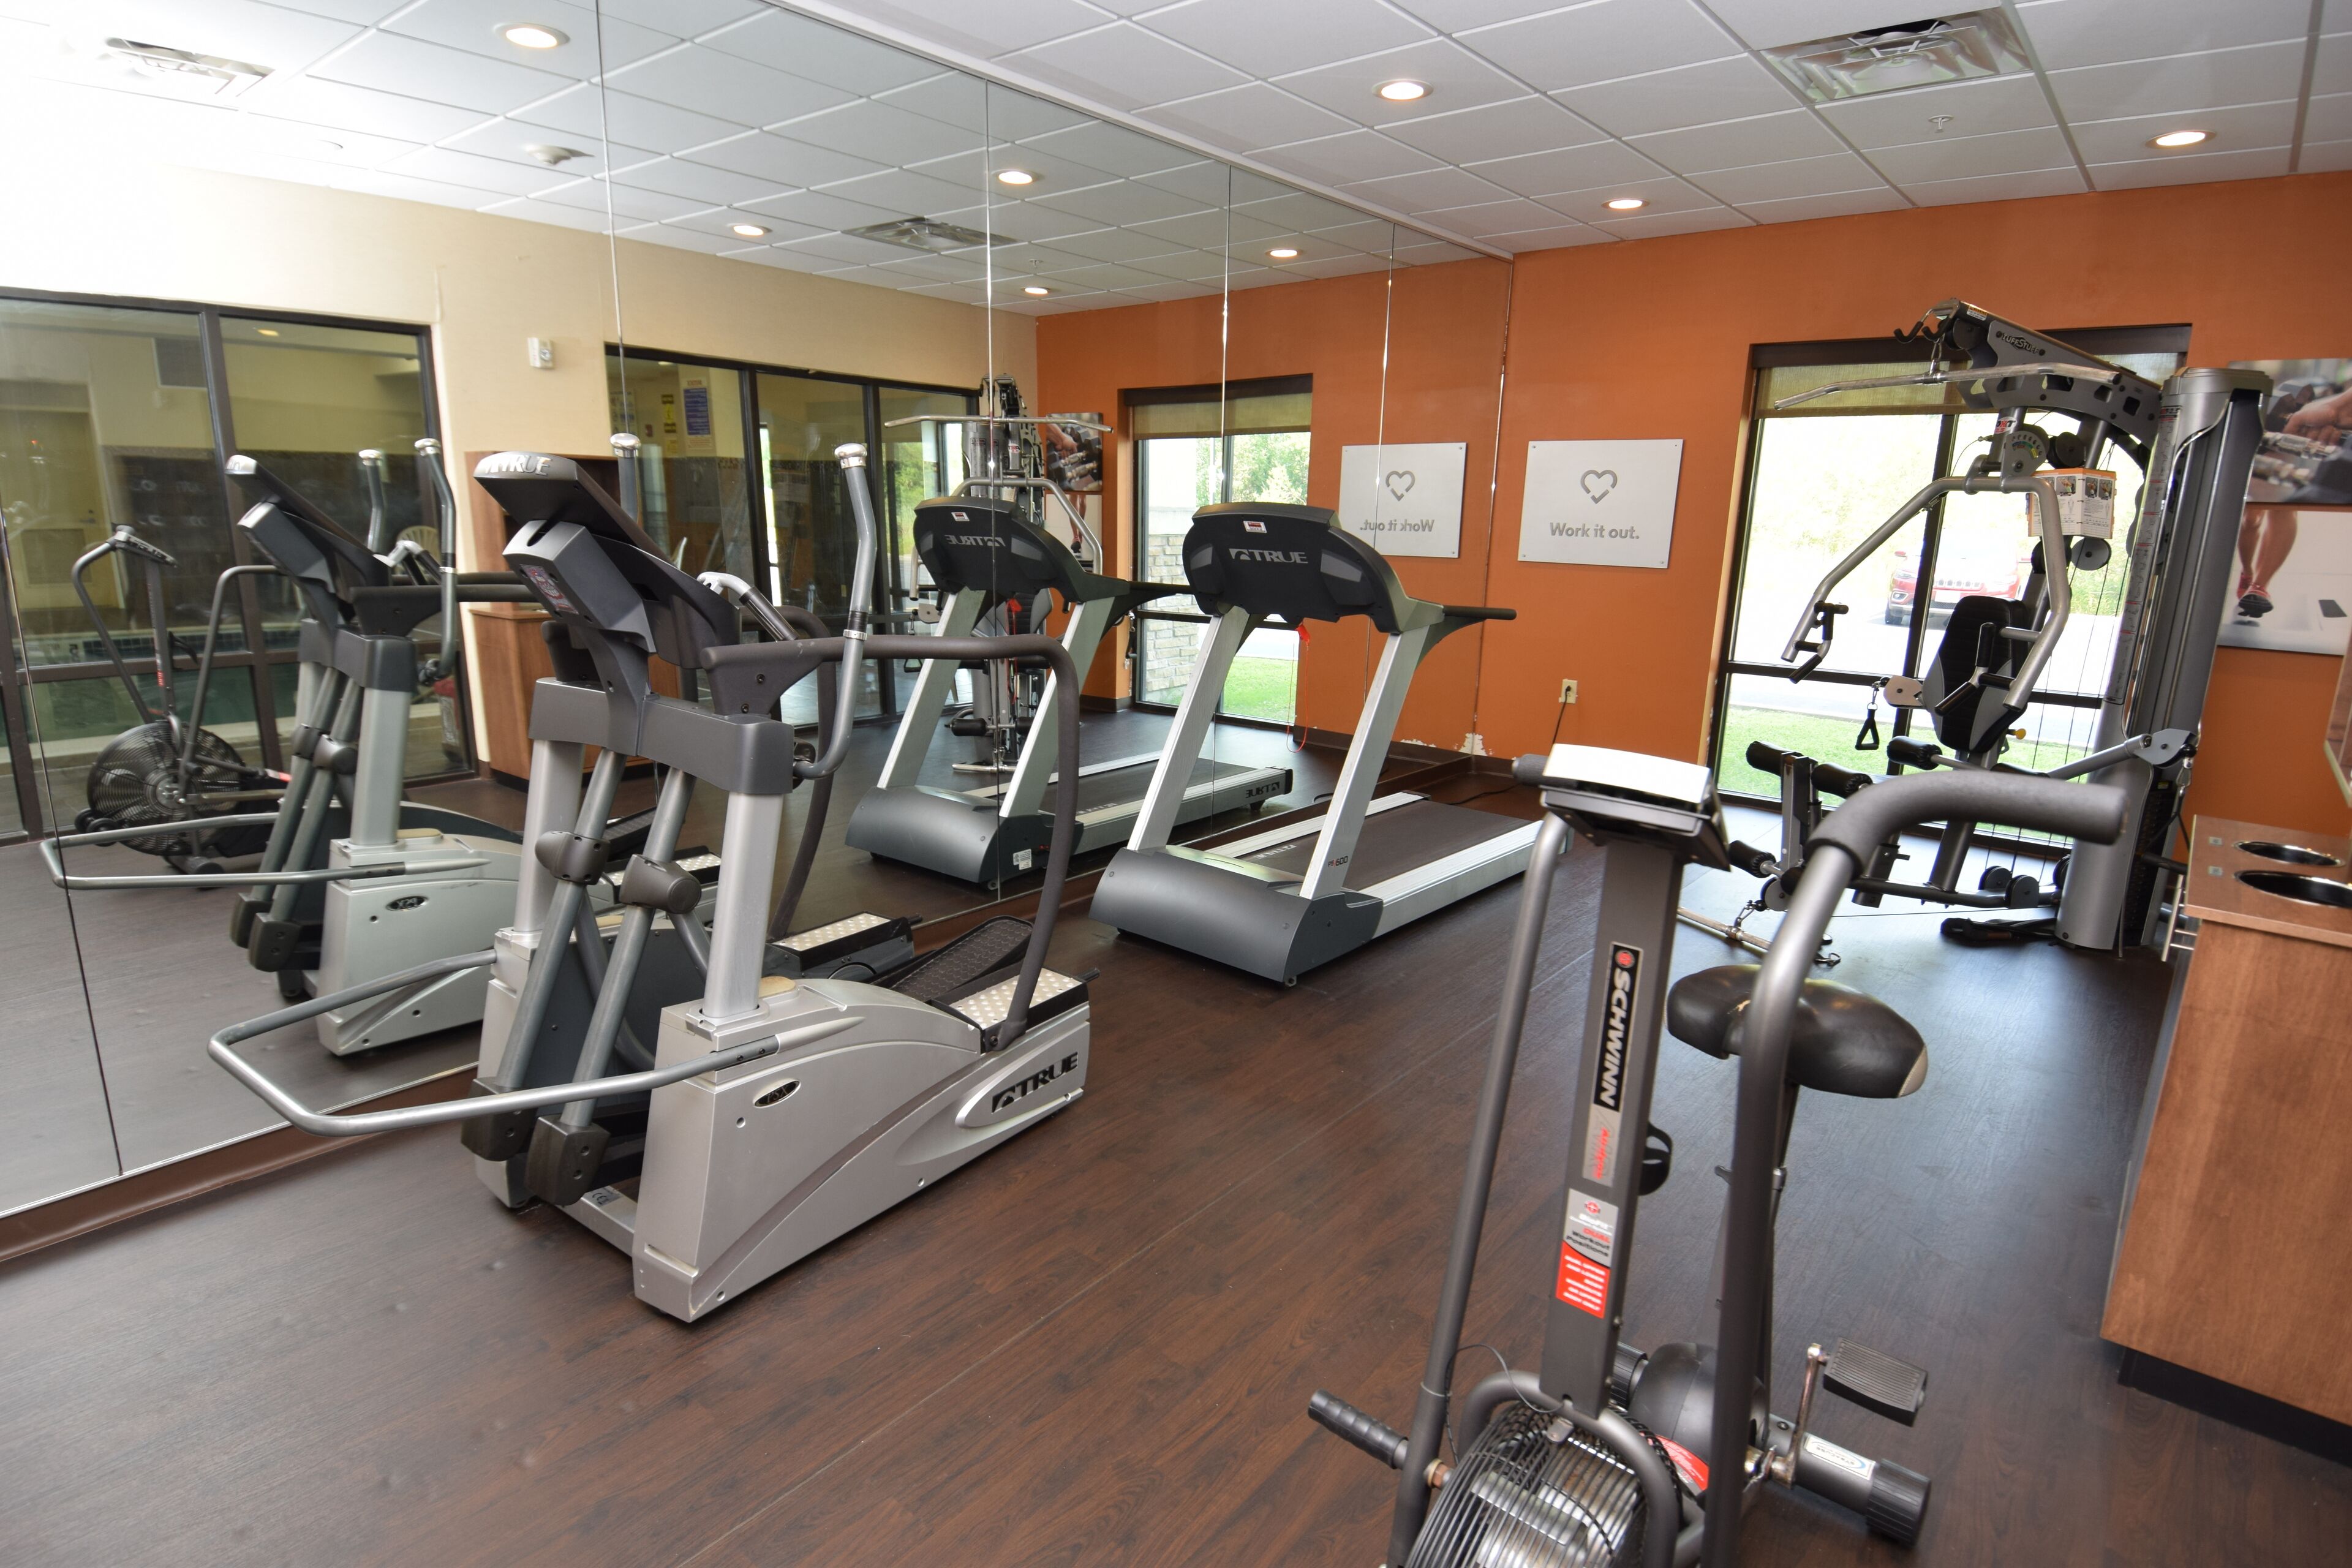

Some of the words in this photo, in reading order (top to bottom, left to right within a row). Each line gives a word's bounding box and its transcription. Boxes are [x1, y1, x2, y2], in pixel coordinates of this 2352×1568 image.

[1550, 522, 1591, 537] Work
[1594, 524, 1605, 538] it
[1608, 526, 1640, 540] out.
[1248, 549, 1309, 564] TRUE
[1599, 967, 1631, 1107] SCHWINN
[1016, 1051, 1079, 1098] TRUE
